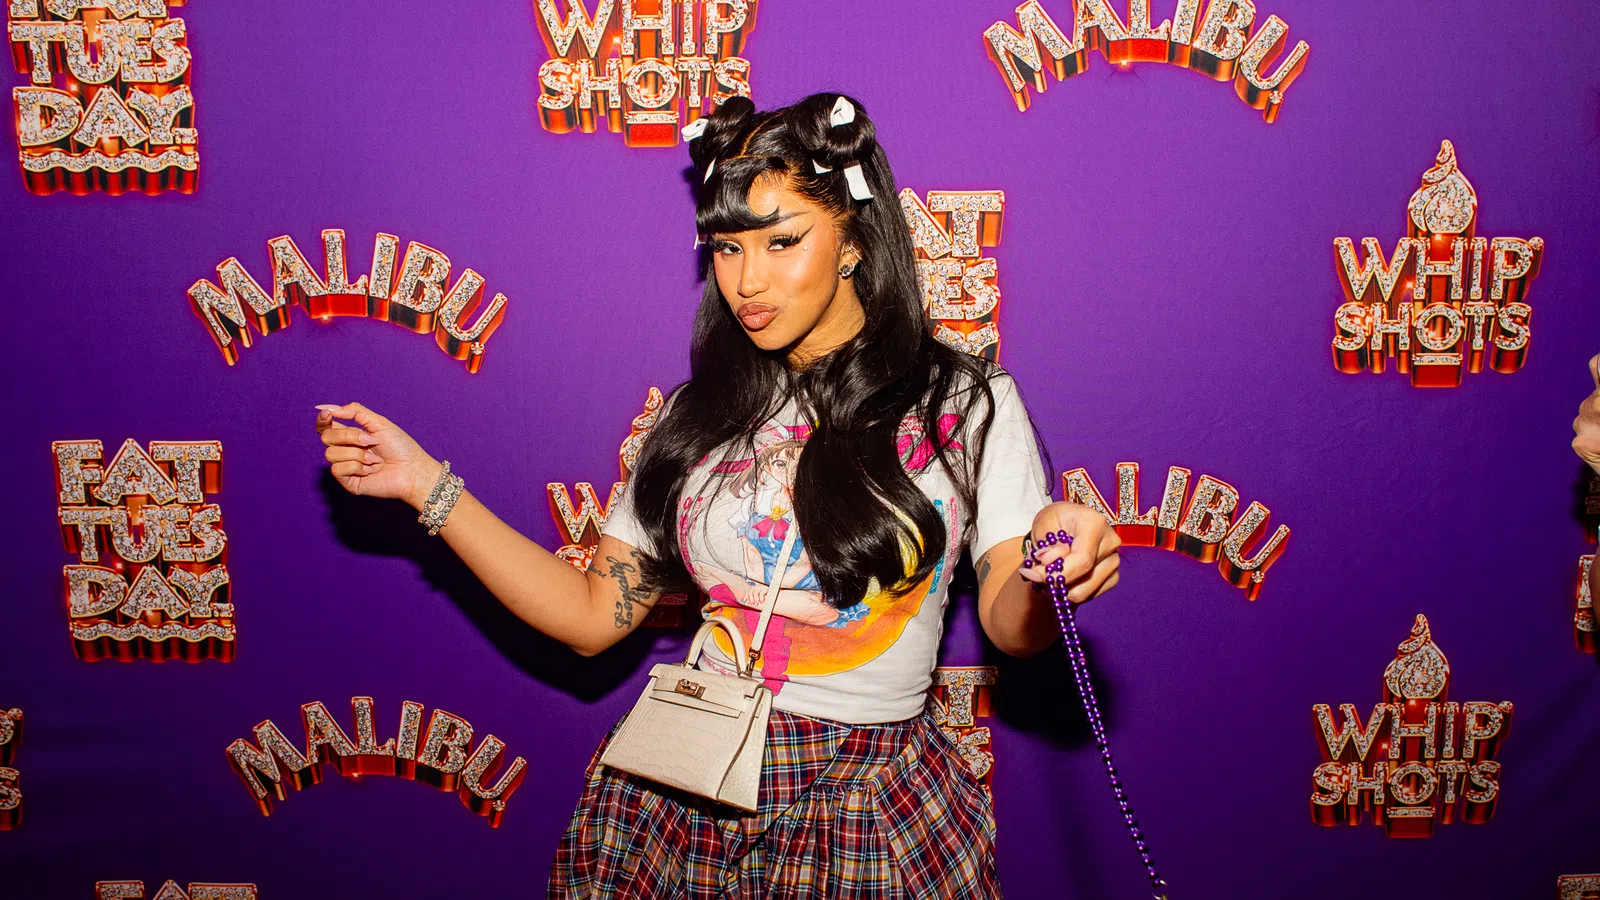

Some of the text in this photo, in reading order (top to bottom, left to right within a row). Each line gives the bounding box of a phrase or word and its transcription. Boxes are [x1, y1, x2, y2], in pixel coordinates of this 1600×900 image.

[8, 18, 191, 84] TUES
[538, 0, 749, 57] WHIP
[983, 0, 1310, 92] MALIBU
[537, 57, 751, 109] SHOTS
[187, 228, 508, 348] MALIBU
[1333, 236, 1534, 300] WHIP
[1332, 302, 1532, 351] SHOTS
[52, 438, 223, 504] FAT
[58, 503, 227, 563] TUES
[1062, 462, 1290, 571] ALIBU
[226, 696, 527, 801] MALIBU
[1312, 701, 1503, 760] WHIP
[1311, 761, 1501, 805] SHOTS
